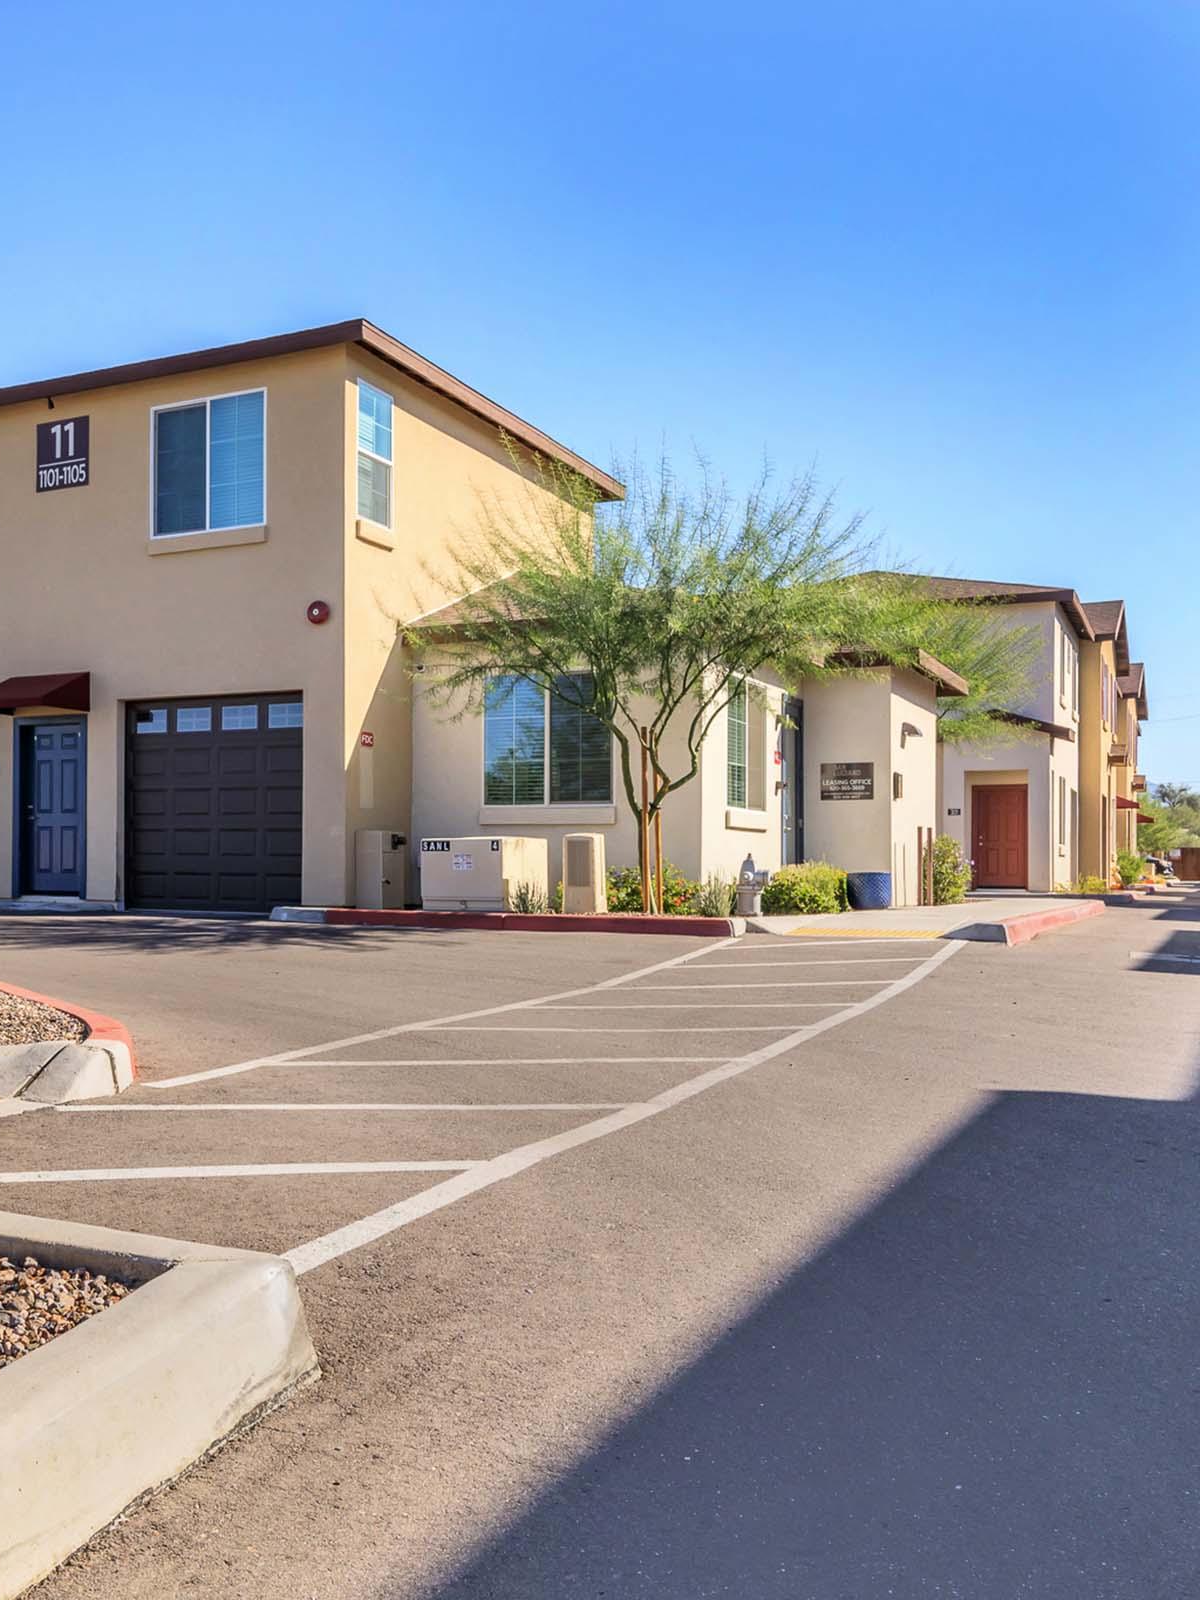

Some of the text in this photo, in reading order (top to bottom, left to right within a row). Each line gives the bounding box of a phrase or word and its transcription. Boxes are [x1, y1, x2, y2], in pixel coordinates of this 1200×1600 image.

[51, 421, 74, 459] 11
[39, 463, 86, 488] 1101-1105
[361, 735, 374, 745] FDC
[822, 778, 872, 786] LEASING OFFICE
[422, 841, 498, 851] SANL 4
